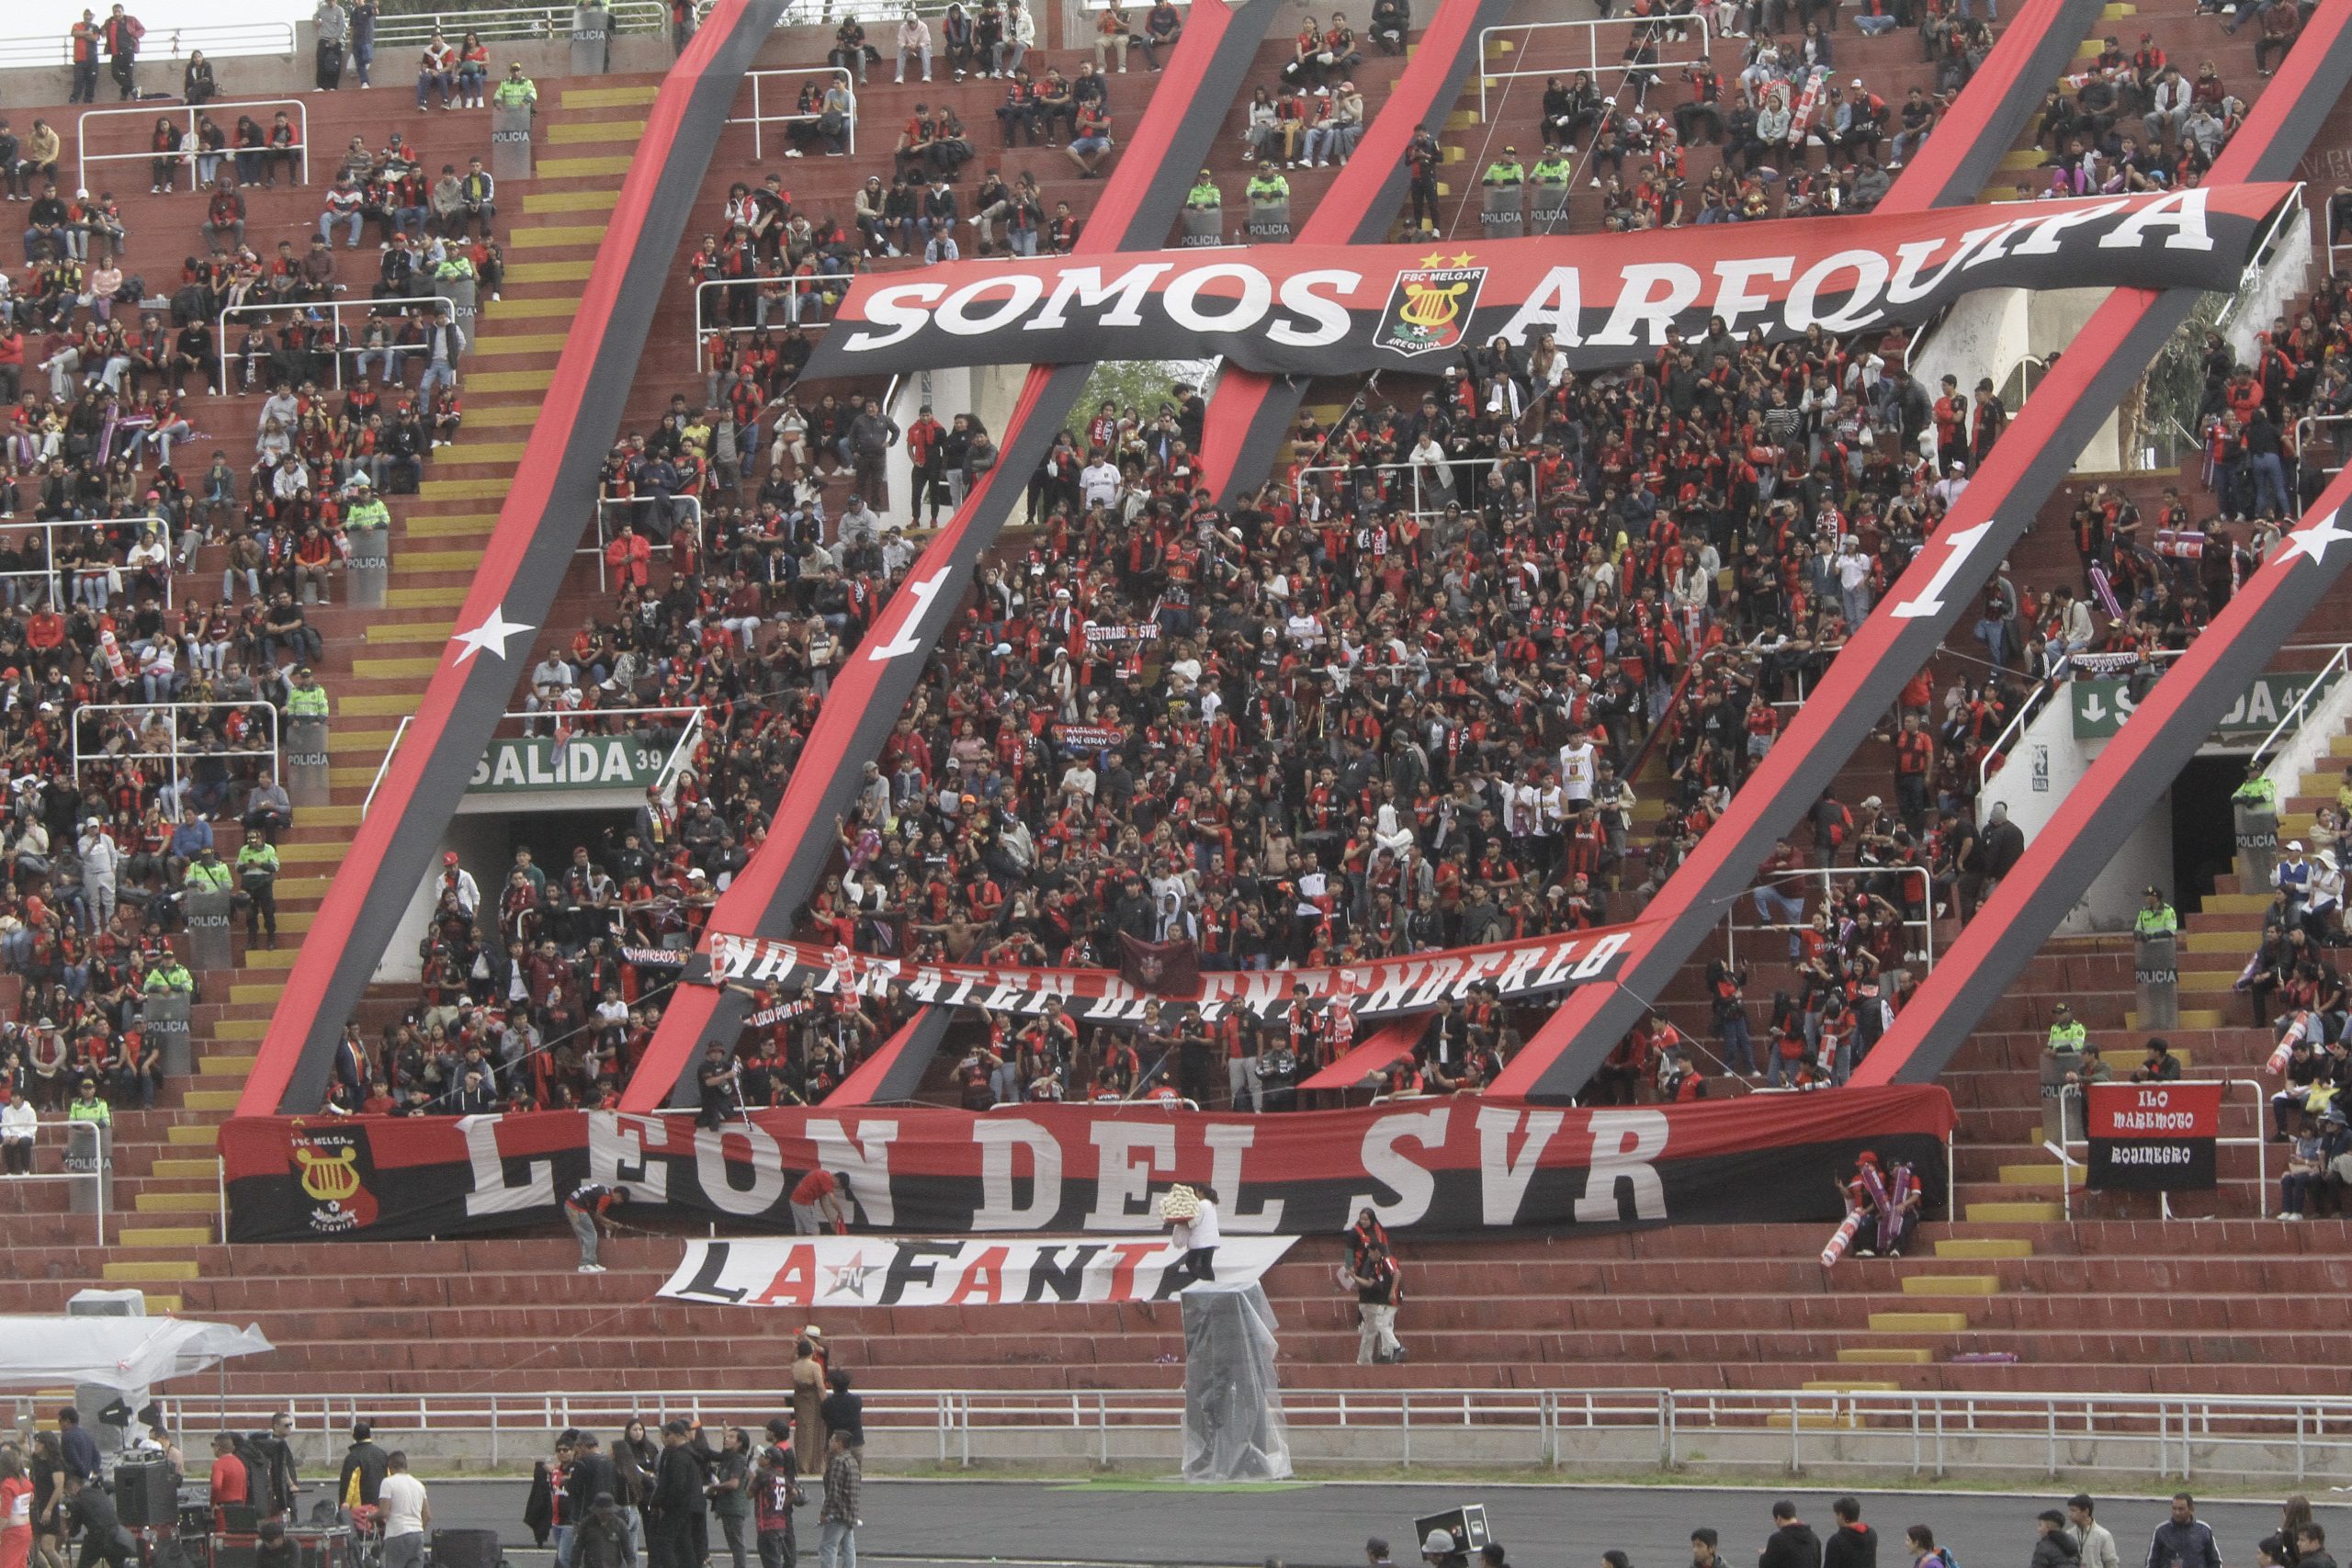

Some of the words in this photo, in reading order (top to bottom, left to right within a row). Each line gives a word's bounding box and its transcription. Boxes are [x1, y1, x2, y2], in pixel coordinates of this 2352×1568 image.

[842, 263, 1363, 352] SOMOS
[1487, 186, 2214, 347] AREQUIPA
[1402, 273, 1428, 282] FBC
[1430, 270, 1481, 281] MELGAR
[1385, 337, 1442, 351] AREQUIPA
[636, 748, 663, 771] 39
[753, 1010, 775, 1027] LOCO
[775, 1003, 793, 1021] POR
[793, 999, 803, 1016] TI
[2138, 1090, 2168, 1108] ILO
[2113, 1111, 2194, 1130] MAREMOTO
[68, 1156, 113, 1169] POLICA
[2111, 1146, 2191, 1165] ROJINEGRO
[465, 1108, 899, 1227] LEON
[969, 1118, 1285, 1234] DEL
[1343, 1105, 1669, 1232] SVR
[675, 1242, 817, 1305] LA
[834, 1266, 867, 1288] FN
